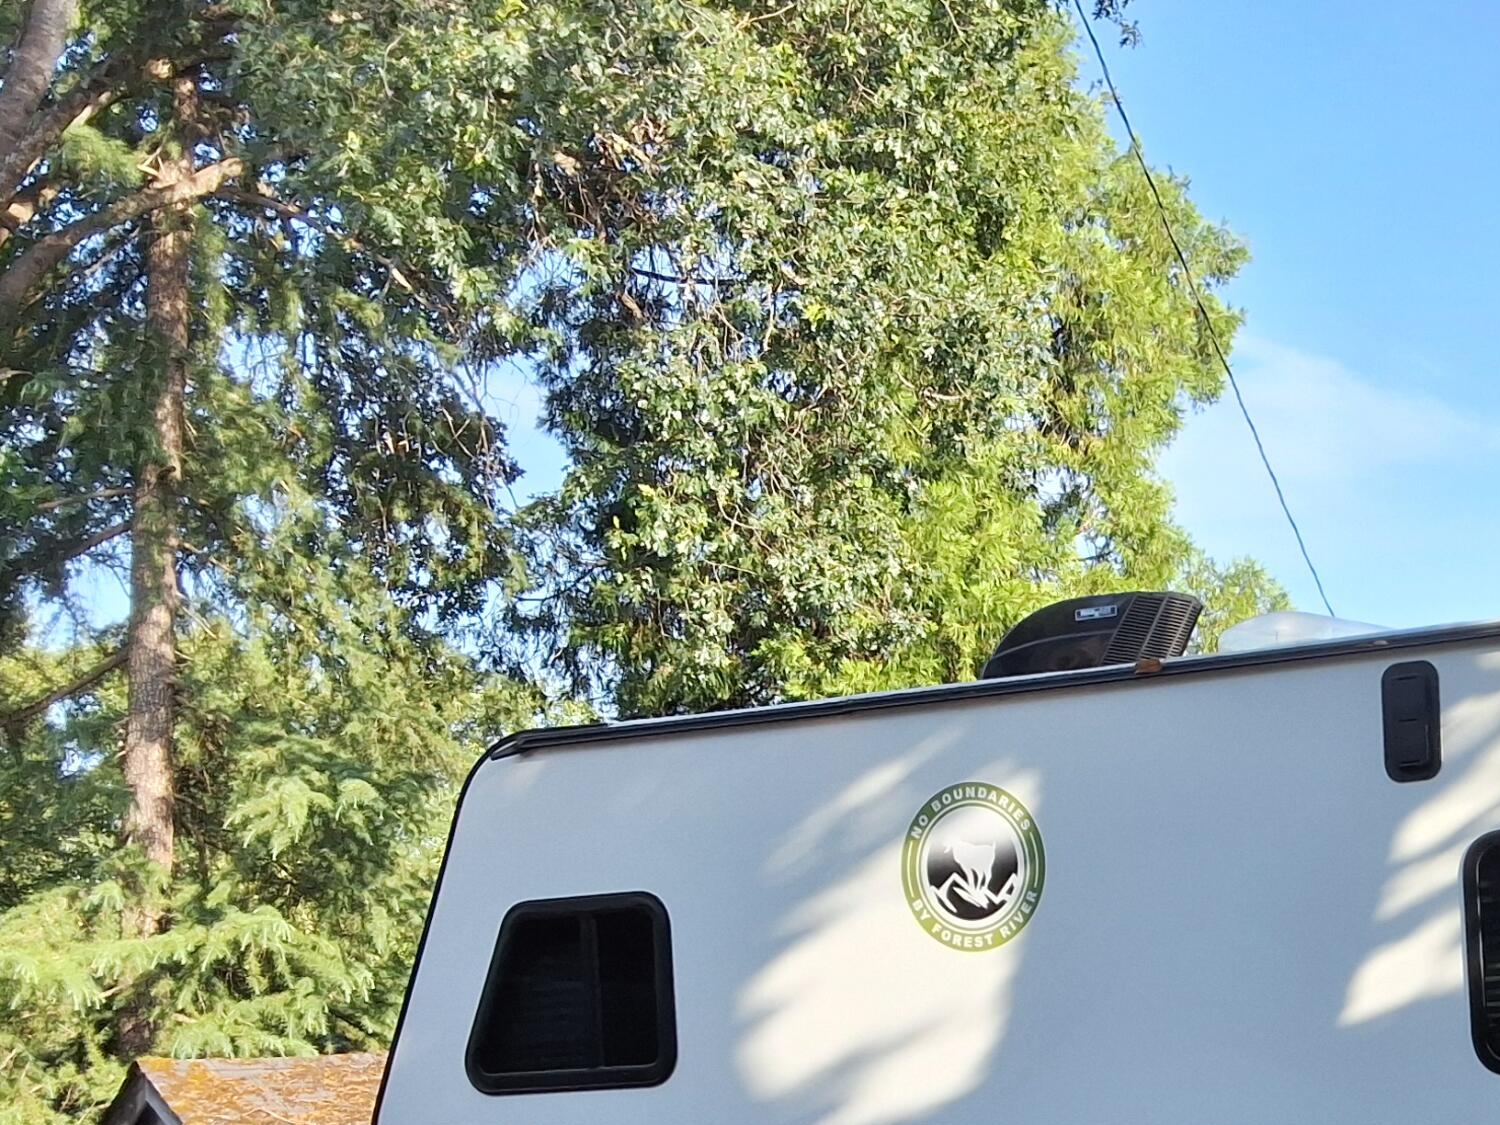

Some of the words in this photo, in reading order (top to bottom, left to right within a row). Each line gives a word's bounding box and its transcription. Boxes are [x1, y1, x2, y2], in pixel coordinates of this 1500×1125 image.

[911, 815, 929, 839] NO
[931, 786, 1031, 831] BOUNDARIES
[911, 898, 931, 921] BY
[932, 923, 995, 948] FOREST
[1000, 891, 1038, 939] RIVER
